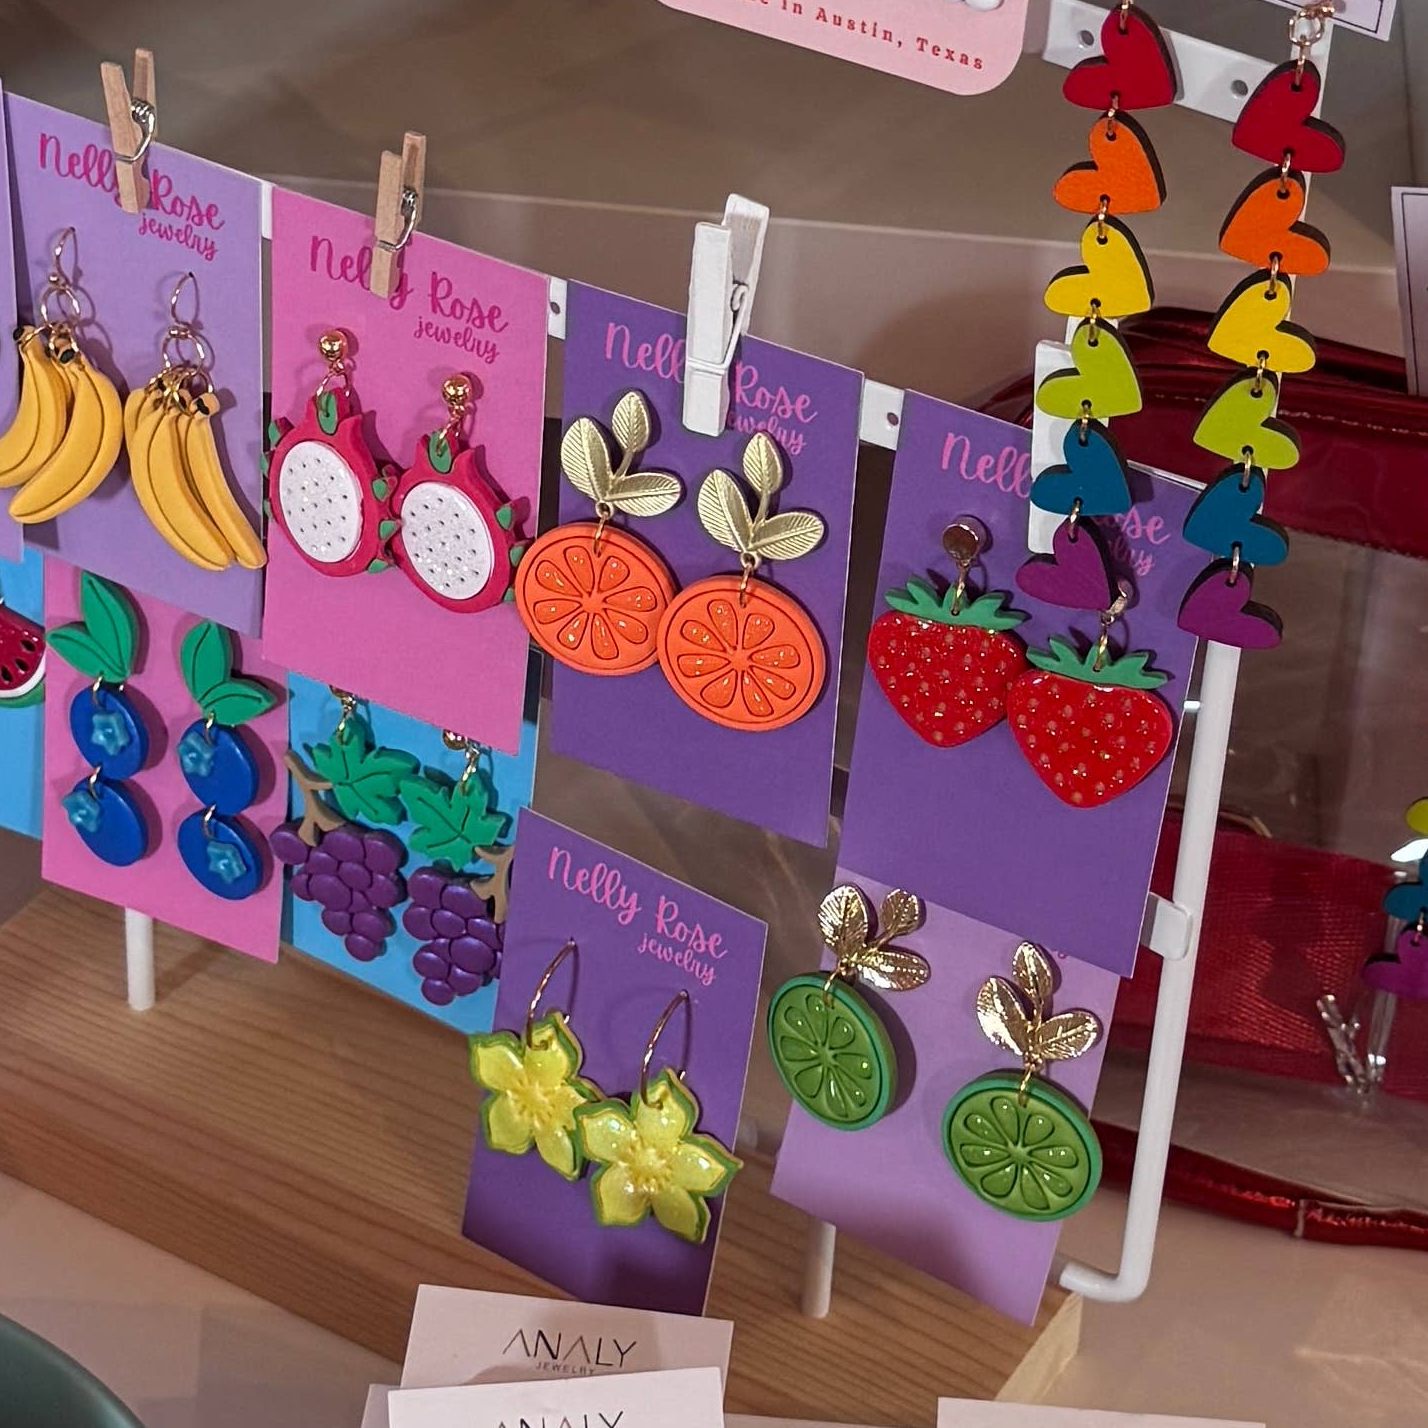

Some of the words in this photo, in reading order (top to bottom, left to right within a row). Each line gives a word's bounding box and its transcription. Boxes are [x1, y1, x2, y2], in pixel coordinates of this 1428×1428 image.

[815, 7, 904, 48] Austin,
[916, 37, 984, 70] Texas
[151, 169, 226, 232] Rose
[138, 210, 219, 262] jewelry
[310, 235, 414, 310] Nely
[428, 271, 509, 333] Rose
[413, 315, 501, 365] jewelry
[604, 322, 686, 384] Nell
[735, 360, 818, 423] Rose
[940, 431, 1031, 499] Nell
[547, 846, 642, 925] Nelly
[655, 895, 729, 959] Rose
[637, 932, 717, 987] jewelry
[502, 1328, 637, 1369] ANALY
[534, 1361, 597, 1375] JEWELRY
